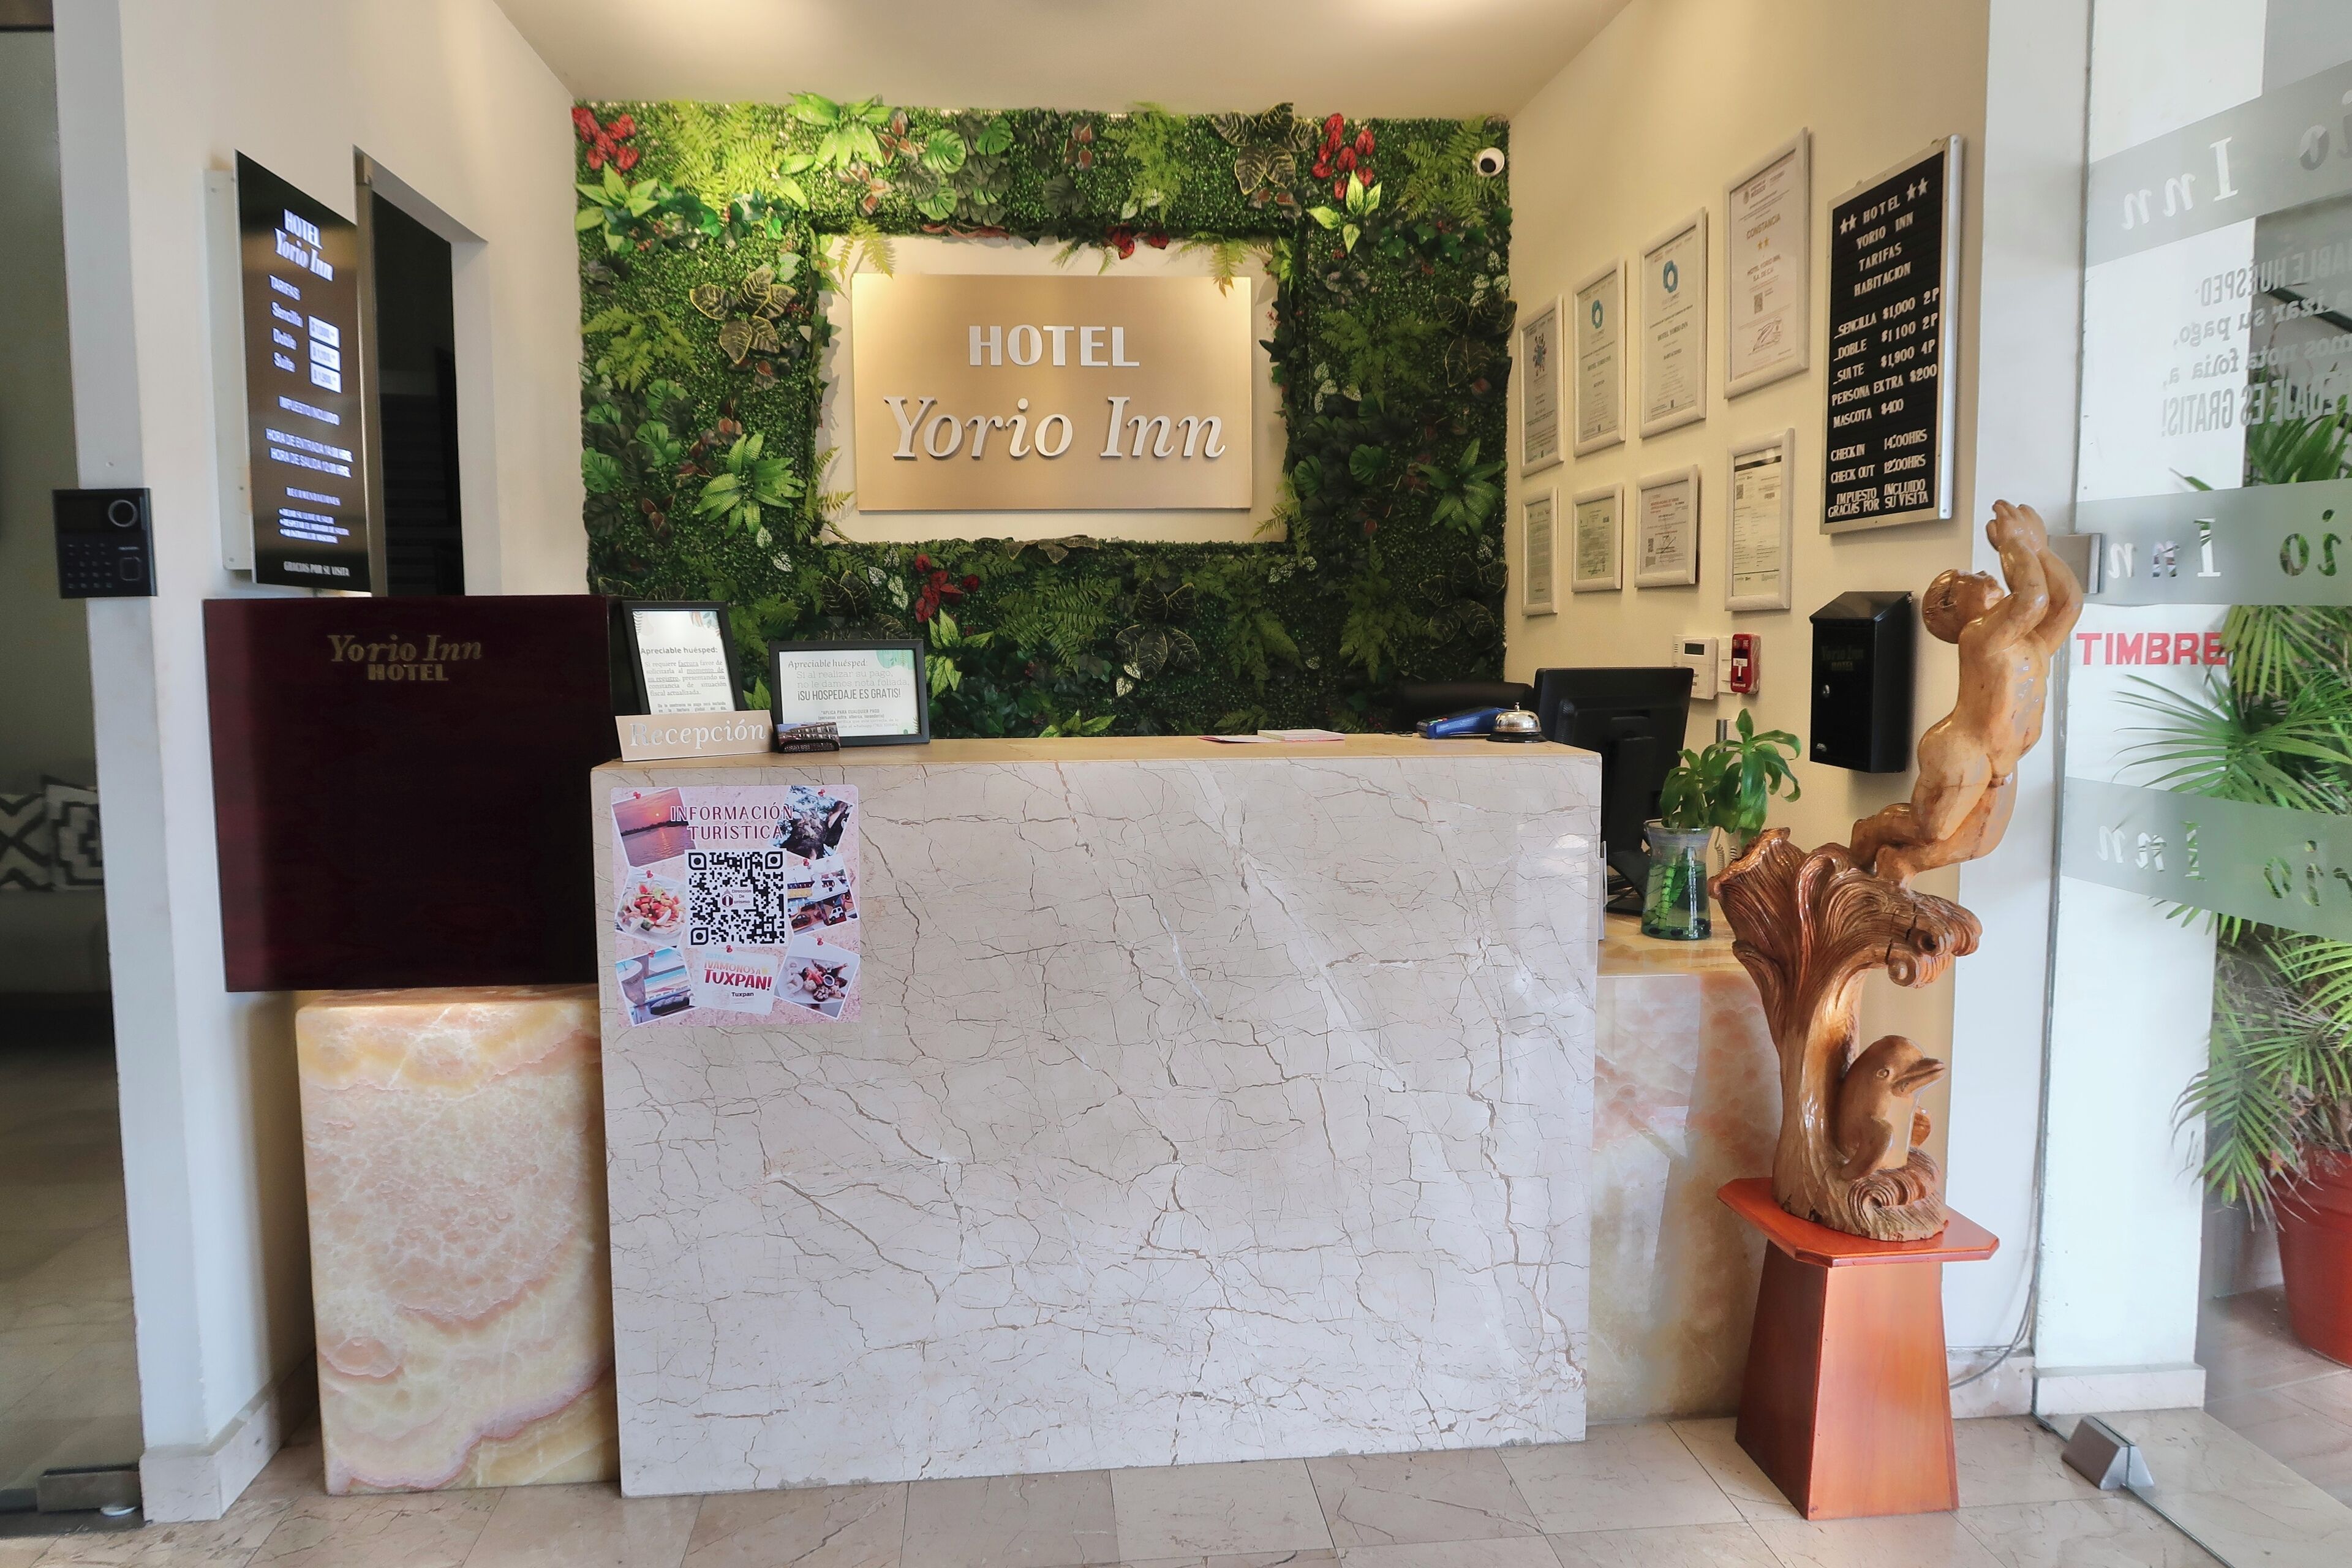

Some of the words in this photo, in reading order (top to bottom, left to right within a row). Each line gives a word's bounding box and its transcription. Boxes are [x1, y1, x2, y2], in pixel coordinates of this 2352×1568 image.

[1863, 195, 1901, 224] HOTEL
[284, 208, 323, 250] HOTEL
[1856, 225, 1887, 250] YORIO
[1895, 211, 1914, 232] INN
[274, 227, 309, 269] Yorio
[309, 247, 333, 282] Inn
[1858, 242, 1902, 272] TARIFAS
[1853, 262, 1912, 297] HABITACION
[1882, 296, 1916, 320] $1,000
[1923, 287, 1940, 305] 2P
[1921, 312, 1938, 330] 2P
[969, 324, 1140, 367] HOTEL
[1921, 339, 1936, 355] 4P
[1831, 384, 1870, 407] PERSONA
[1873, 374, 1904, 394] EXTRA
[1909, 363, 1938, 383] $200
[1833, 407, 1872, 429] MASCOTA
[1881, 398, 1904, 416] $400
[883, 395, 1073, 461] Yorio
[1099, 395, 1226, 460] Inn
[1830, 446, 1856, 462] CHECK
[1856, 443, 1866, 456] IN
[1830, 468, 1856, 484] CHECK
[1858, 464, 1875, 478] OUT
[1828, 503, 1860, 518] GRACIAS
[1863, 498, 1880, 513] POR
[1885, 496, 1896, 509] SU
[1899, 490, 1929, 507] VISITA
[1837, 488, 1877, 505] IMPUESTO
[1883, 478, 1926, 496] INCLUIDO
[328, 633, 417, 662] Yorio
[423, 634, 482, 661] Inn
[641, 647, 682, 655] Apreciable
[684, 646, 718, 655] huésped:
[2076, 631, 2228, 666] TIMBRE
[368, 663, 449, 681] HOTEL
[788, 659, 831, 669] Apreciable
[832, 658, 868, 669] huésped:
[869, 669, 893, 678] pago,
[797, 690, 810, 701] ¡SU
[812, 689, 858, 700] HOSPEDAJE
[859, 688, 869, 699] ES
[871, 688, 901, 699] GRATIS!
[630, 718, 766, 750] Recepción
[670, 802, 793, 821] INFORMACIÓN
[688, 823, 783, 841] TURÍSTICA
[704, 968, 772, 991] TUXPAN!
